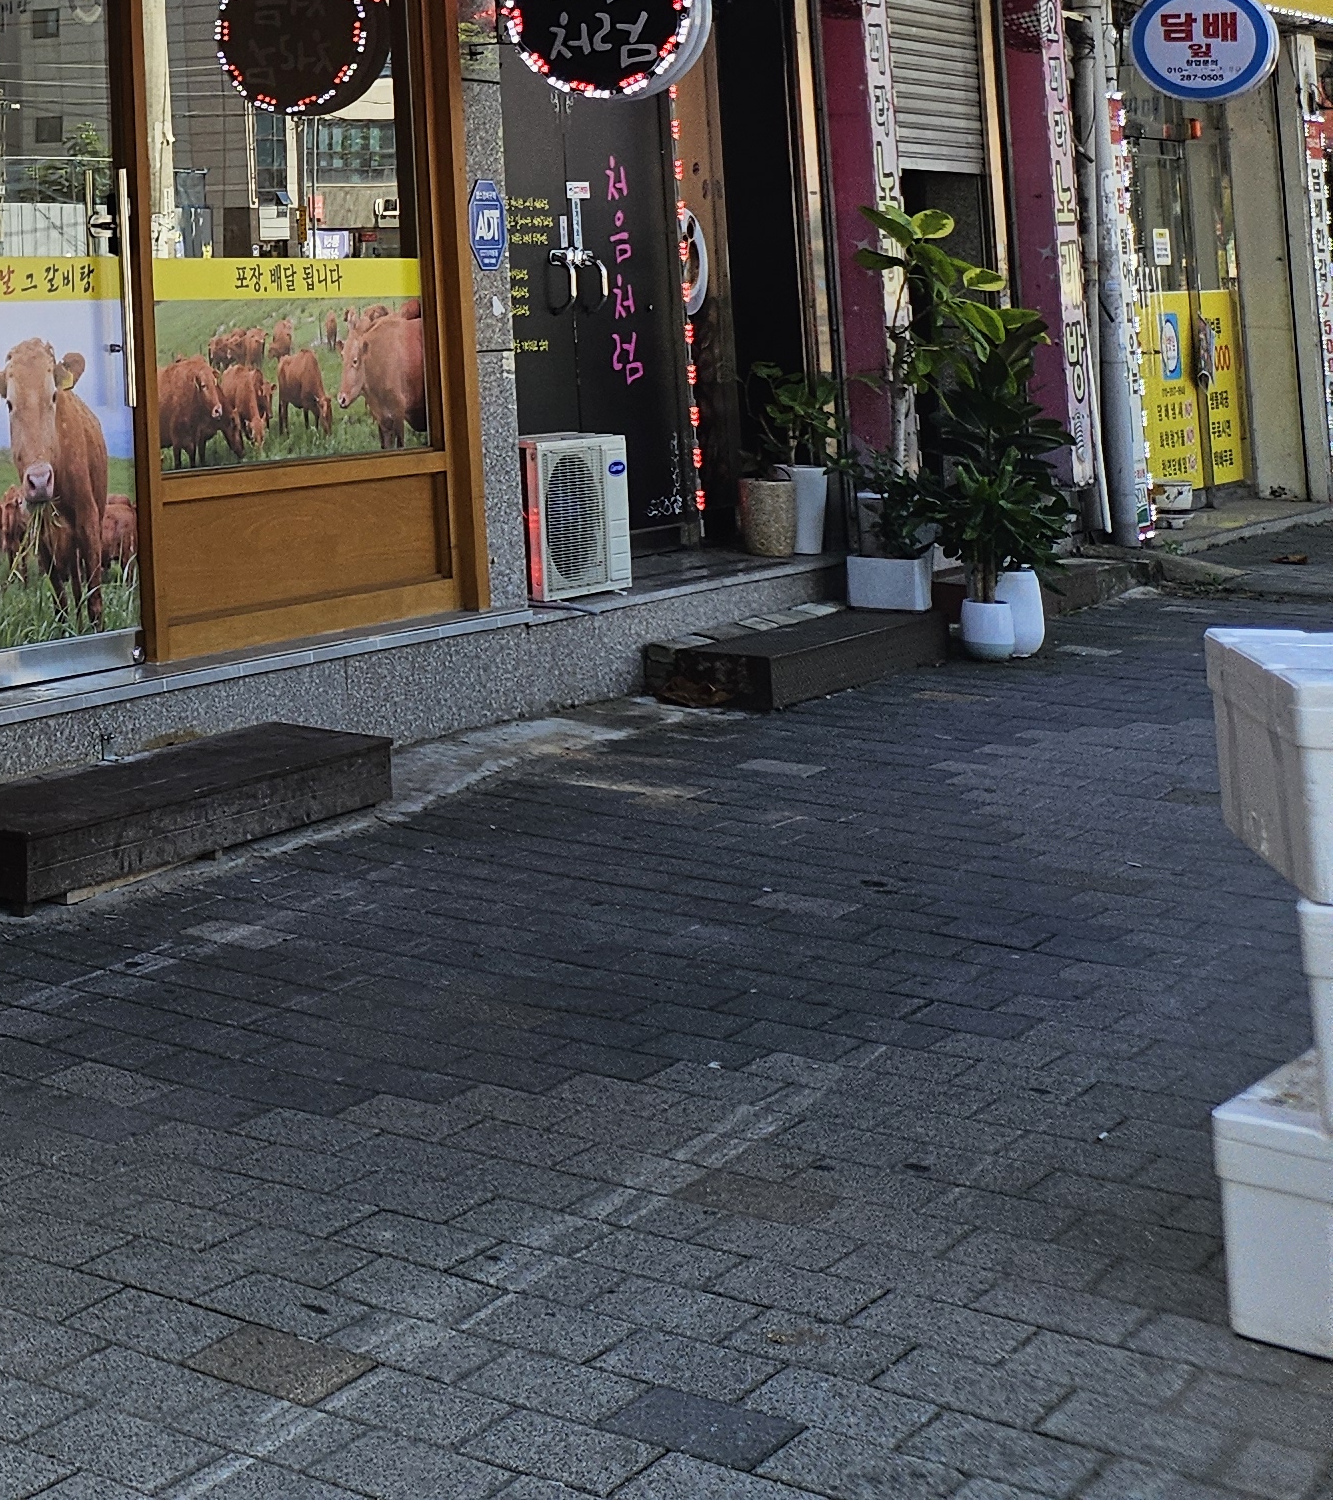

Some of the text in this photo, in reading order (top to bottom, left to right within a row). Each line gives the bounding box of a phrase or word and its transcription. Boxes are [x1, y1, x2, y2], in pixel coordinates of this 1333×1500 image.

[549, 11, 658, 69] 처럼
[1160, 12, 1238, 43] 담배
[474, 209, 500, 241] ADT
[20, 272, 38, 291] 그
[43, 263, 95, 294] 갈비탕
[302, 262, 343, 292] 됩니다
